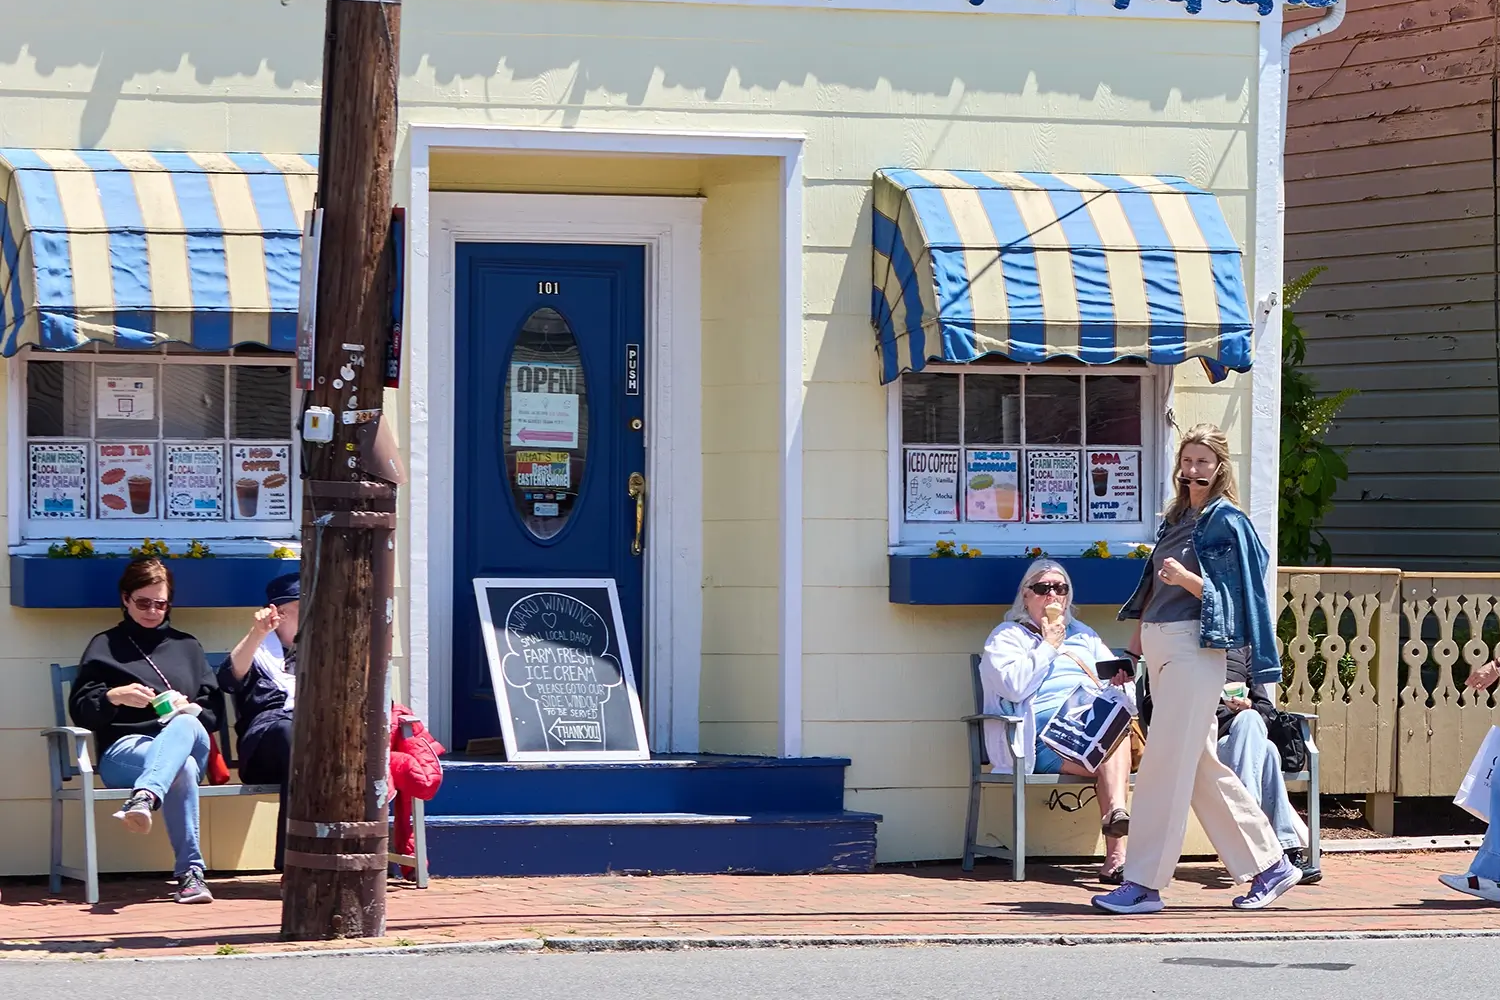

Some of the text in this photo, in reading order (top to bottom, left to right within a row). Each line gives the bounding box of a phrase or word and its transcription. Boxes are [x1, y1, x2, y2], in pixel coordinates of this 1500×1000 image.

[538, 282, 559, 295] 101
[629, 350, 637, 389] PUSH
[516, 366, 574, 394] OPEN
[518, 452, 568, 462] WHAT'S UP
[908, 452, 957, 474] ICED COFFEE
[1034, 459, 1074, 468] FARM FRESH
[1091, 453, 1121, 464] SODA
[37, 465, 59, 474] LOCAL
[174, 465, 196, 474] LOCAL
[532, 463, 552, 474] Best
[1035, 470, 1054, 479] LOCAL
[518, 473, 568, 486] EASTERN SHORE
[1035, 480, 1074, 492] ICE CREAM
[508, 596, 596, 638] AWARD WINNING
[520, 630, 592, 648] SMALL LOCAL DAIRY
[523, 648, 595, 666] FARM FRESH
[525, 666, 597, 682] ICE CREAM
[536, 683, 566, 694] PLEASE
[588, 684, 605, 696] OUR
[541, 695, 598, 708] SIDE WINDOW
[558, 708, 568, 716] BE
[570, 709, 598, 719] SERVED
[554, 726, 584, 739] THANK
